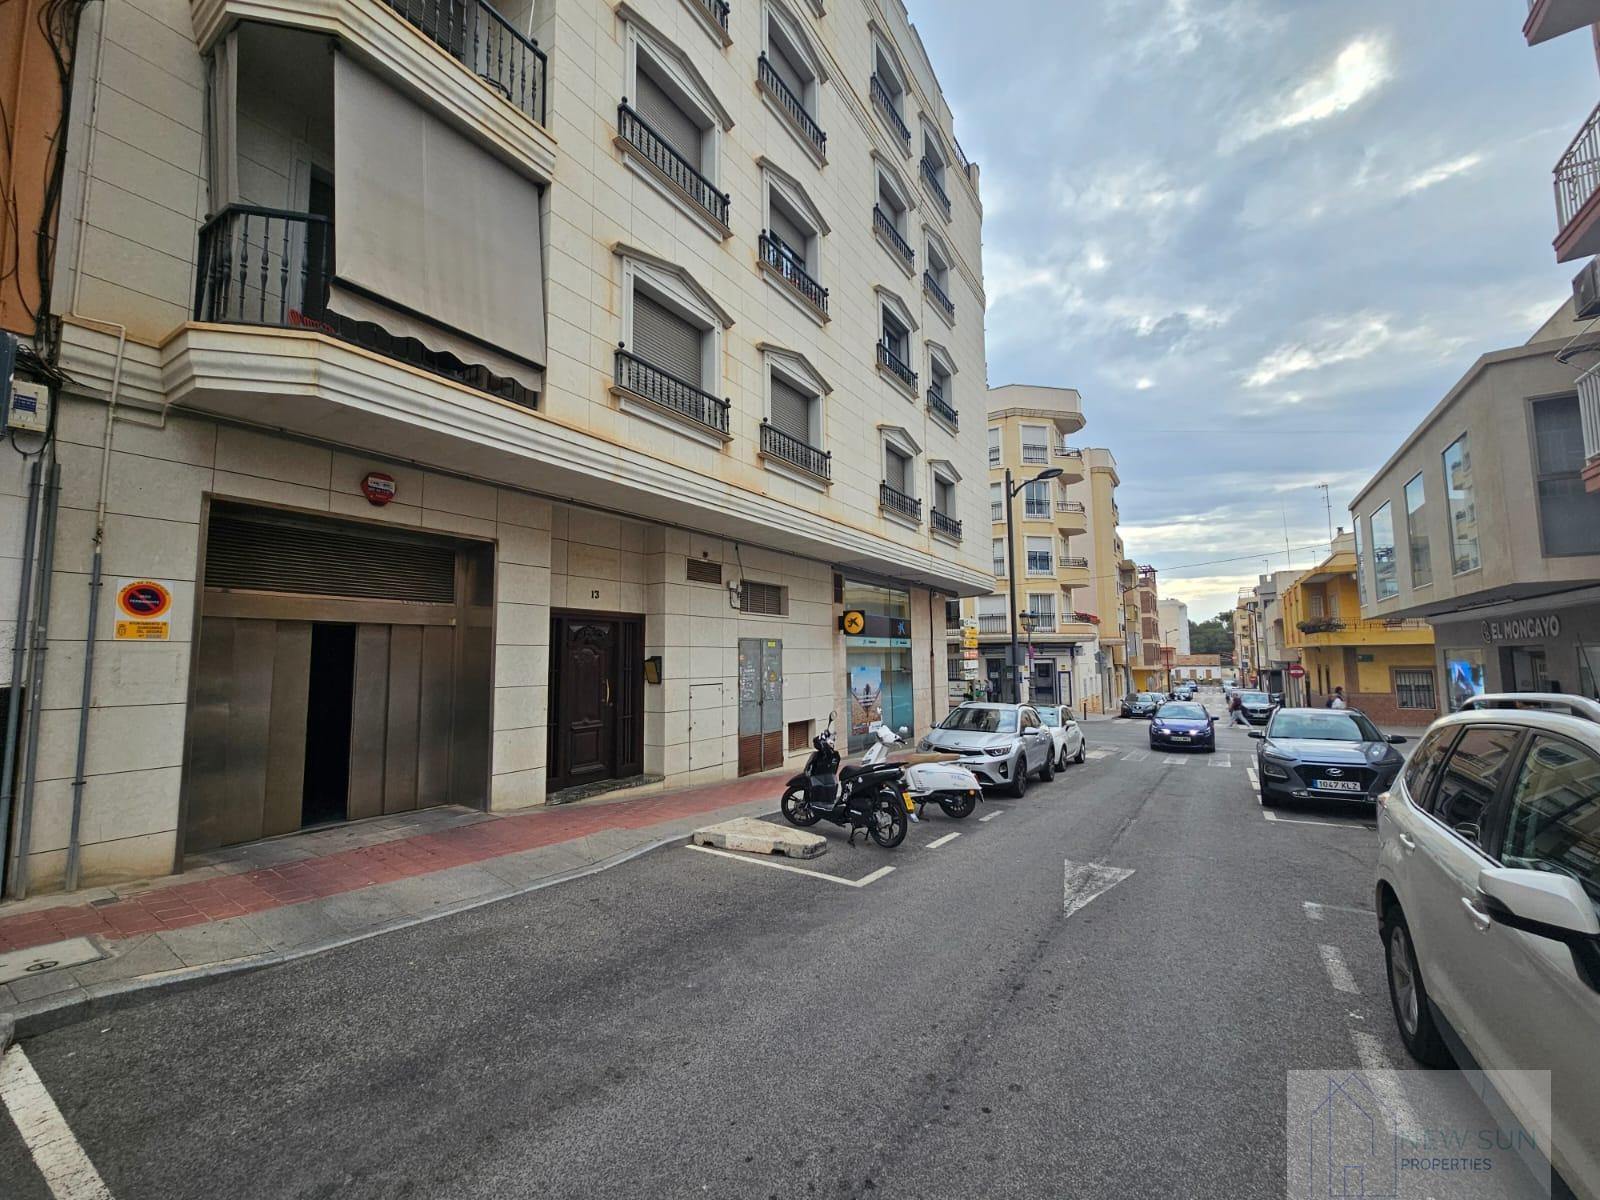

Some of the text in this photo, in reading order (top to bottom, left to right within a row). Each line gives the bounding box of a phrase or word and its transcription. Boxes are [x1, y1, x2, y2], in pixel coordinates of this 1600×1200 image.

[591, 590, 600, 599] 13
[1491, 615, 1559, 640] EL MONCAYO
